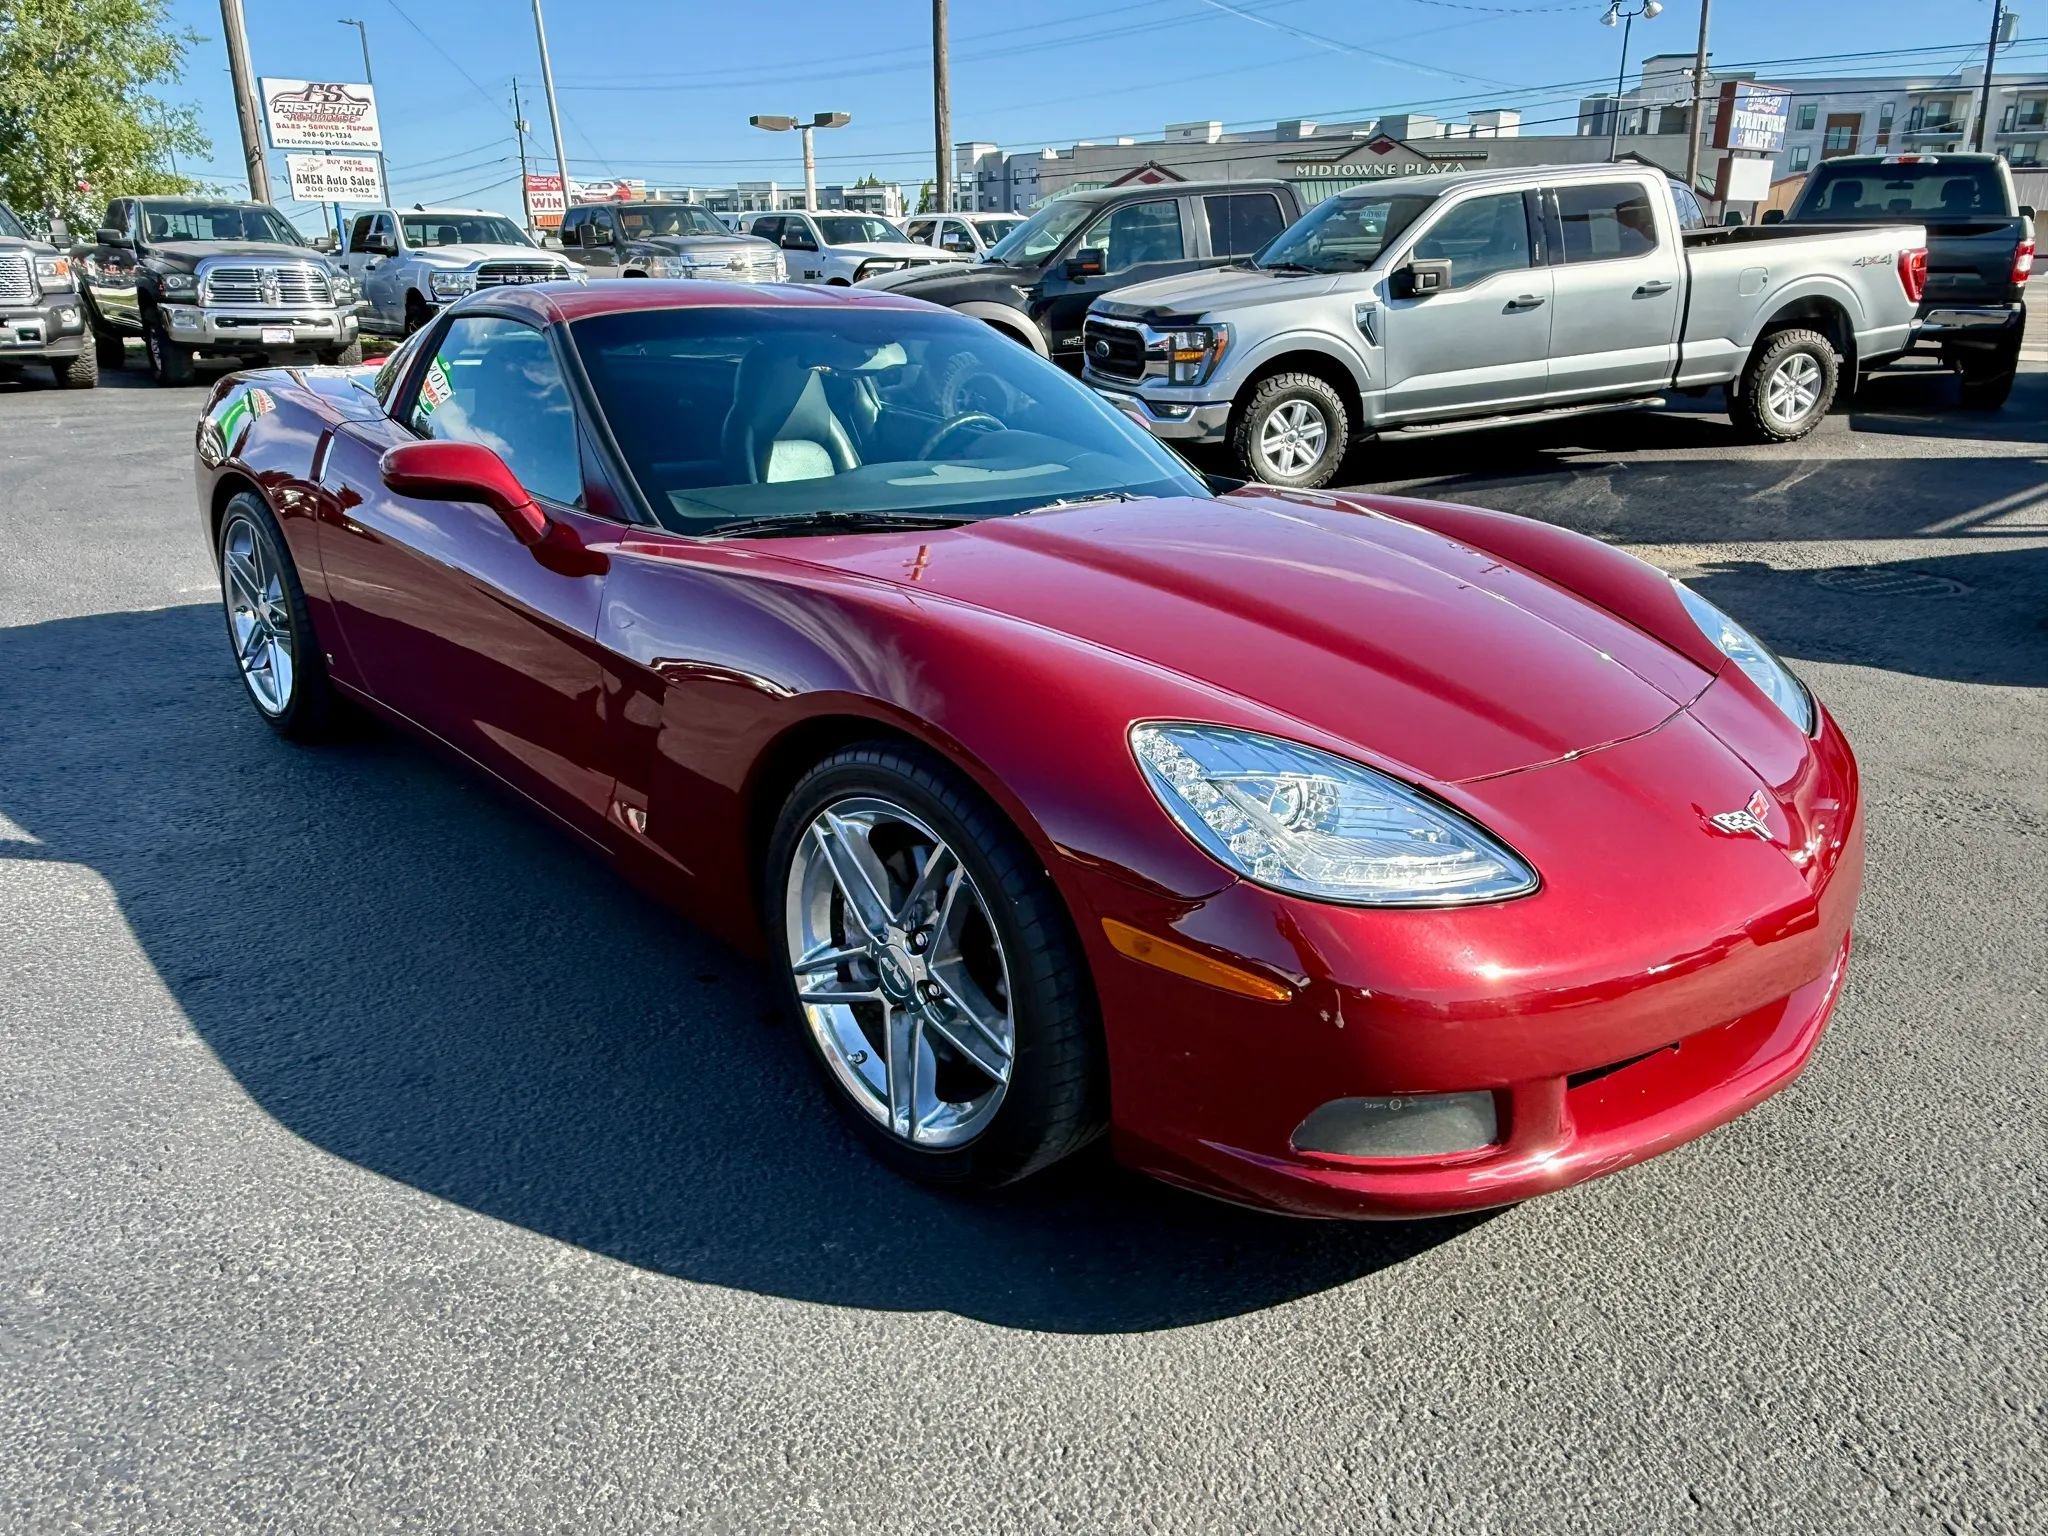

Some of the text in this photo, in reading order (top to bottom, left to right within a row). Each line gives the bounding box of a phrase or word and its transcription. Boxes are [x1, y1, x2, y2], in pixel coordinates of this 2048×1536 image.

[273, 100, 368, 117] FRESH START
[1733, 110, 1786, 132] FURNITURE
[1743, 129, 1772, 148] MART
[1296, 162, 1466, 177] MIDTOWNE PLAZA
[296, 174, 376, 187] AMEN Auto Sales
[531, 197, 562, 209] WIN
